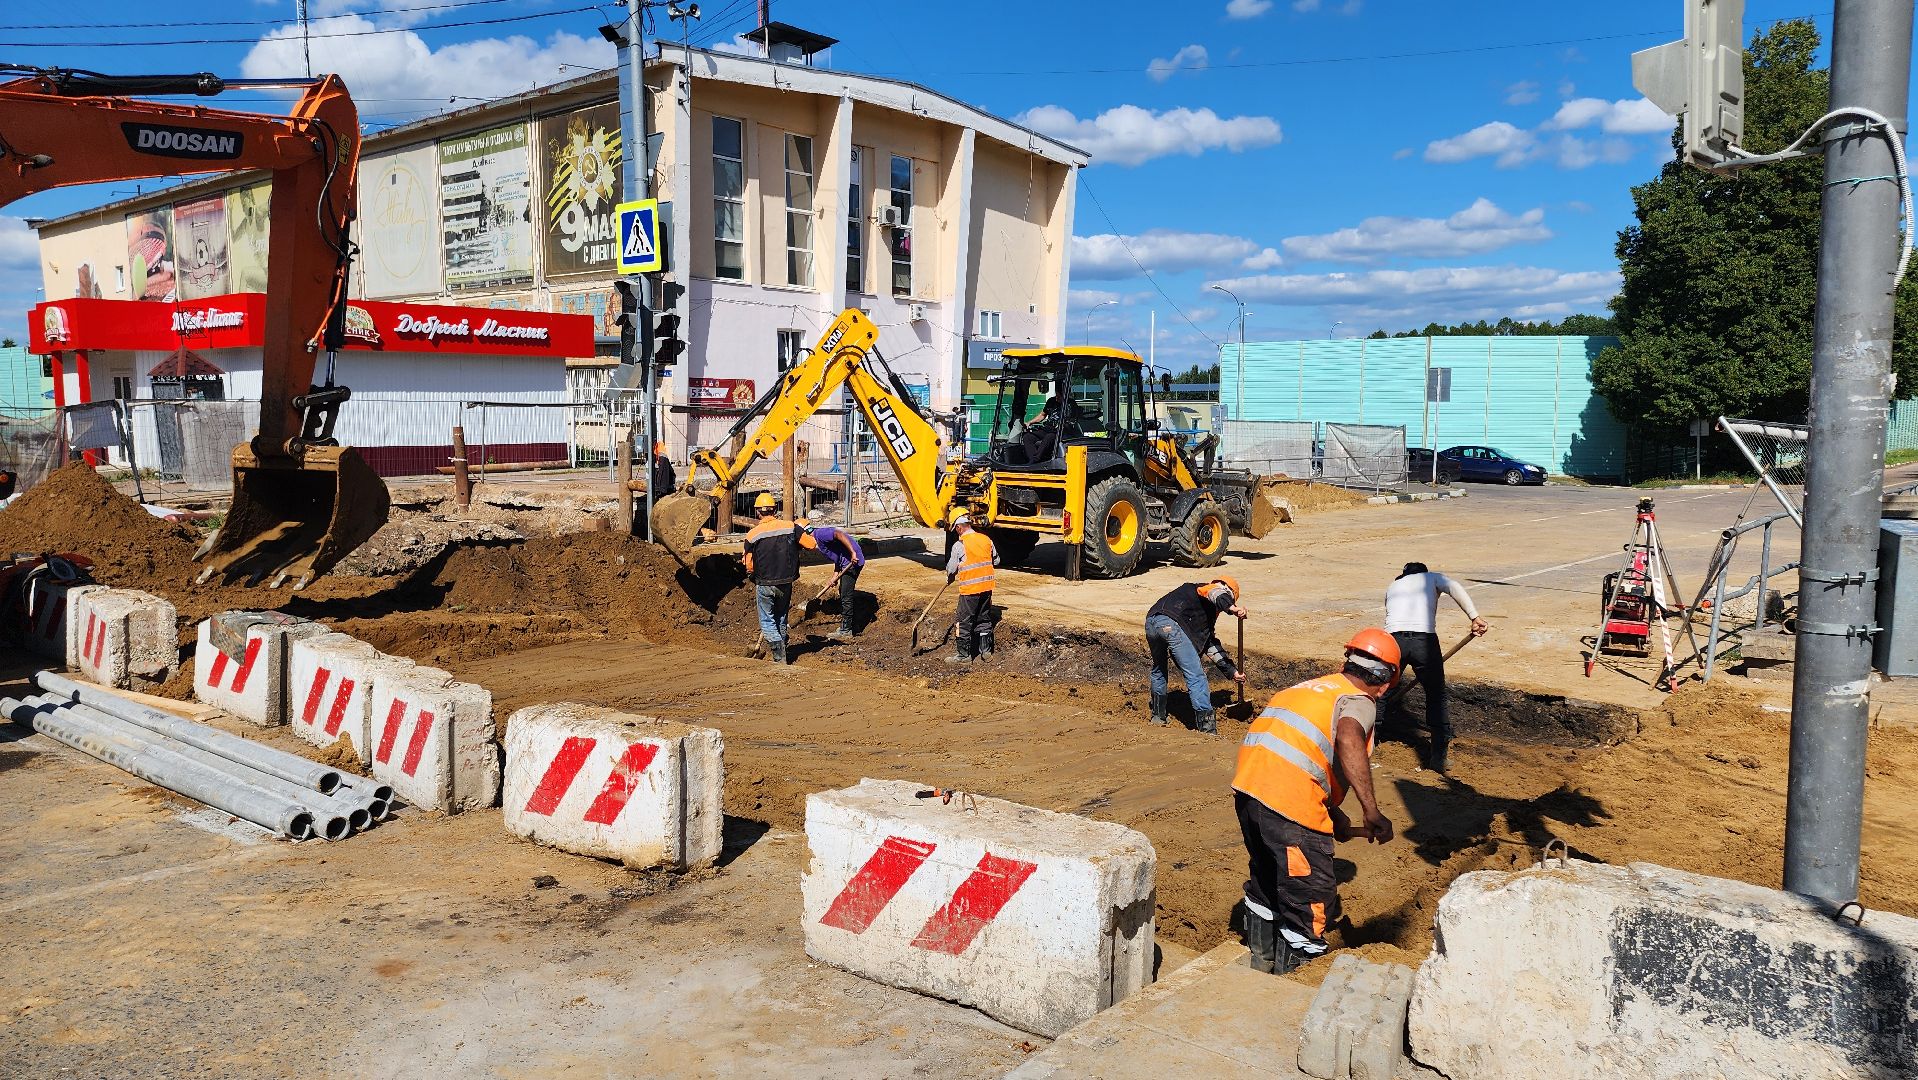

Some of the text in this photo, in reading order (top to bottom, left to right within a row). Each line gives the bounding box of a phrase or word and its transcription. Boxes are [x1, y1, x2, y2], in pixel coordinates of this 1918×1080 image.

[138, 129, 235, 153] DOOSAN
[560, 201, 584, 252] 9
[346, 328, 371, 337] СНИК
[394, 314, 548, 340] Добрый Мясник
[984, 353, 1004, 362] ПРОЗ
[872, 403, 914, 460] JCB
